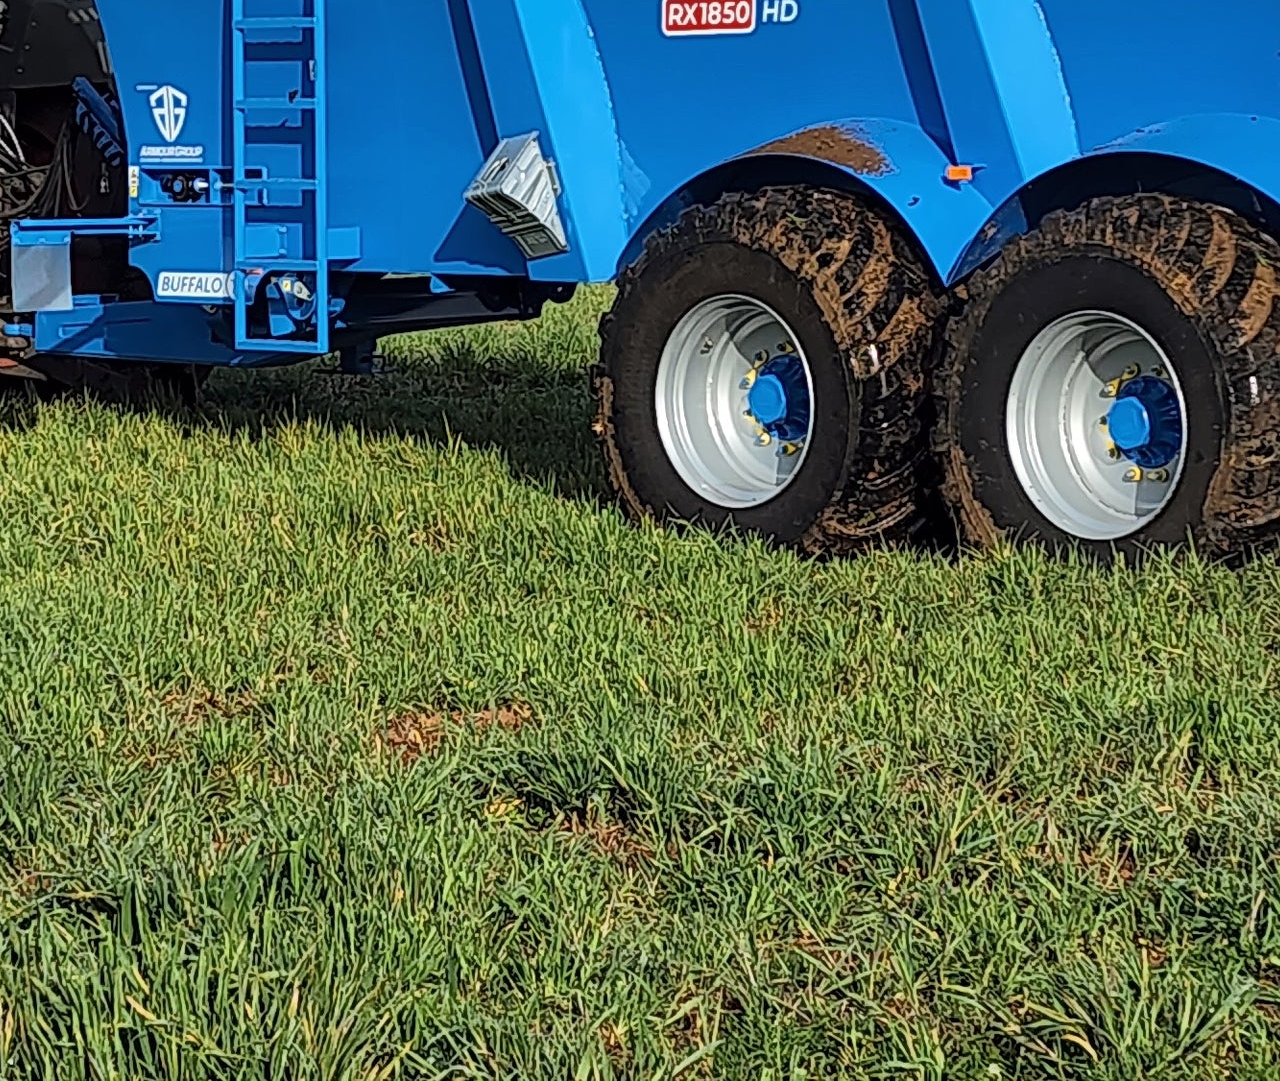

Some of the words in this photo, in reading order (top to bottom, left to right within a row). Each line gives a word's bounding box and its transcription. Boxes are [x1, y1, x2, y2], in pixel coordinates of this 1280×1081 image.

[668, 1, 750, 26] RX1850
[762, 0, 798, 22] HD
[161, 275, 223, 293] BUFFALO
